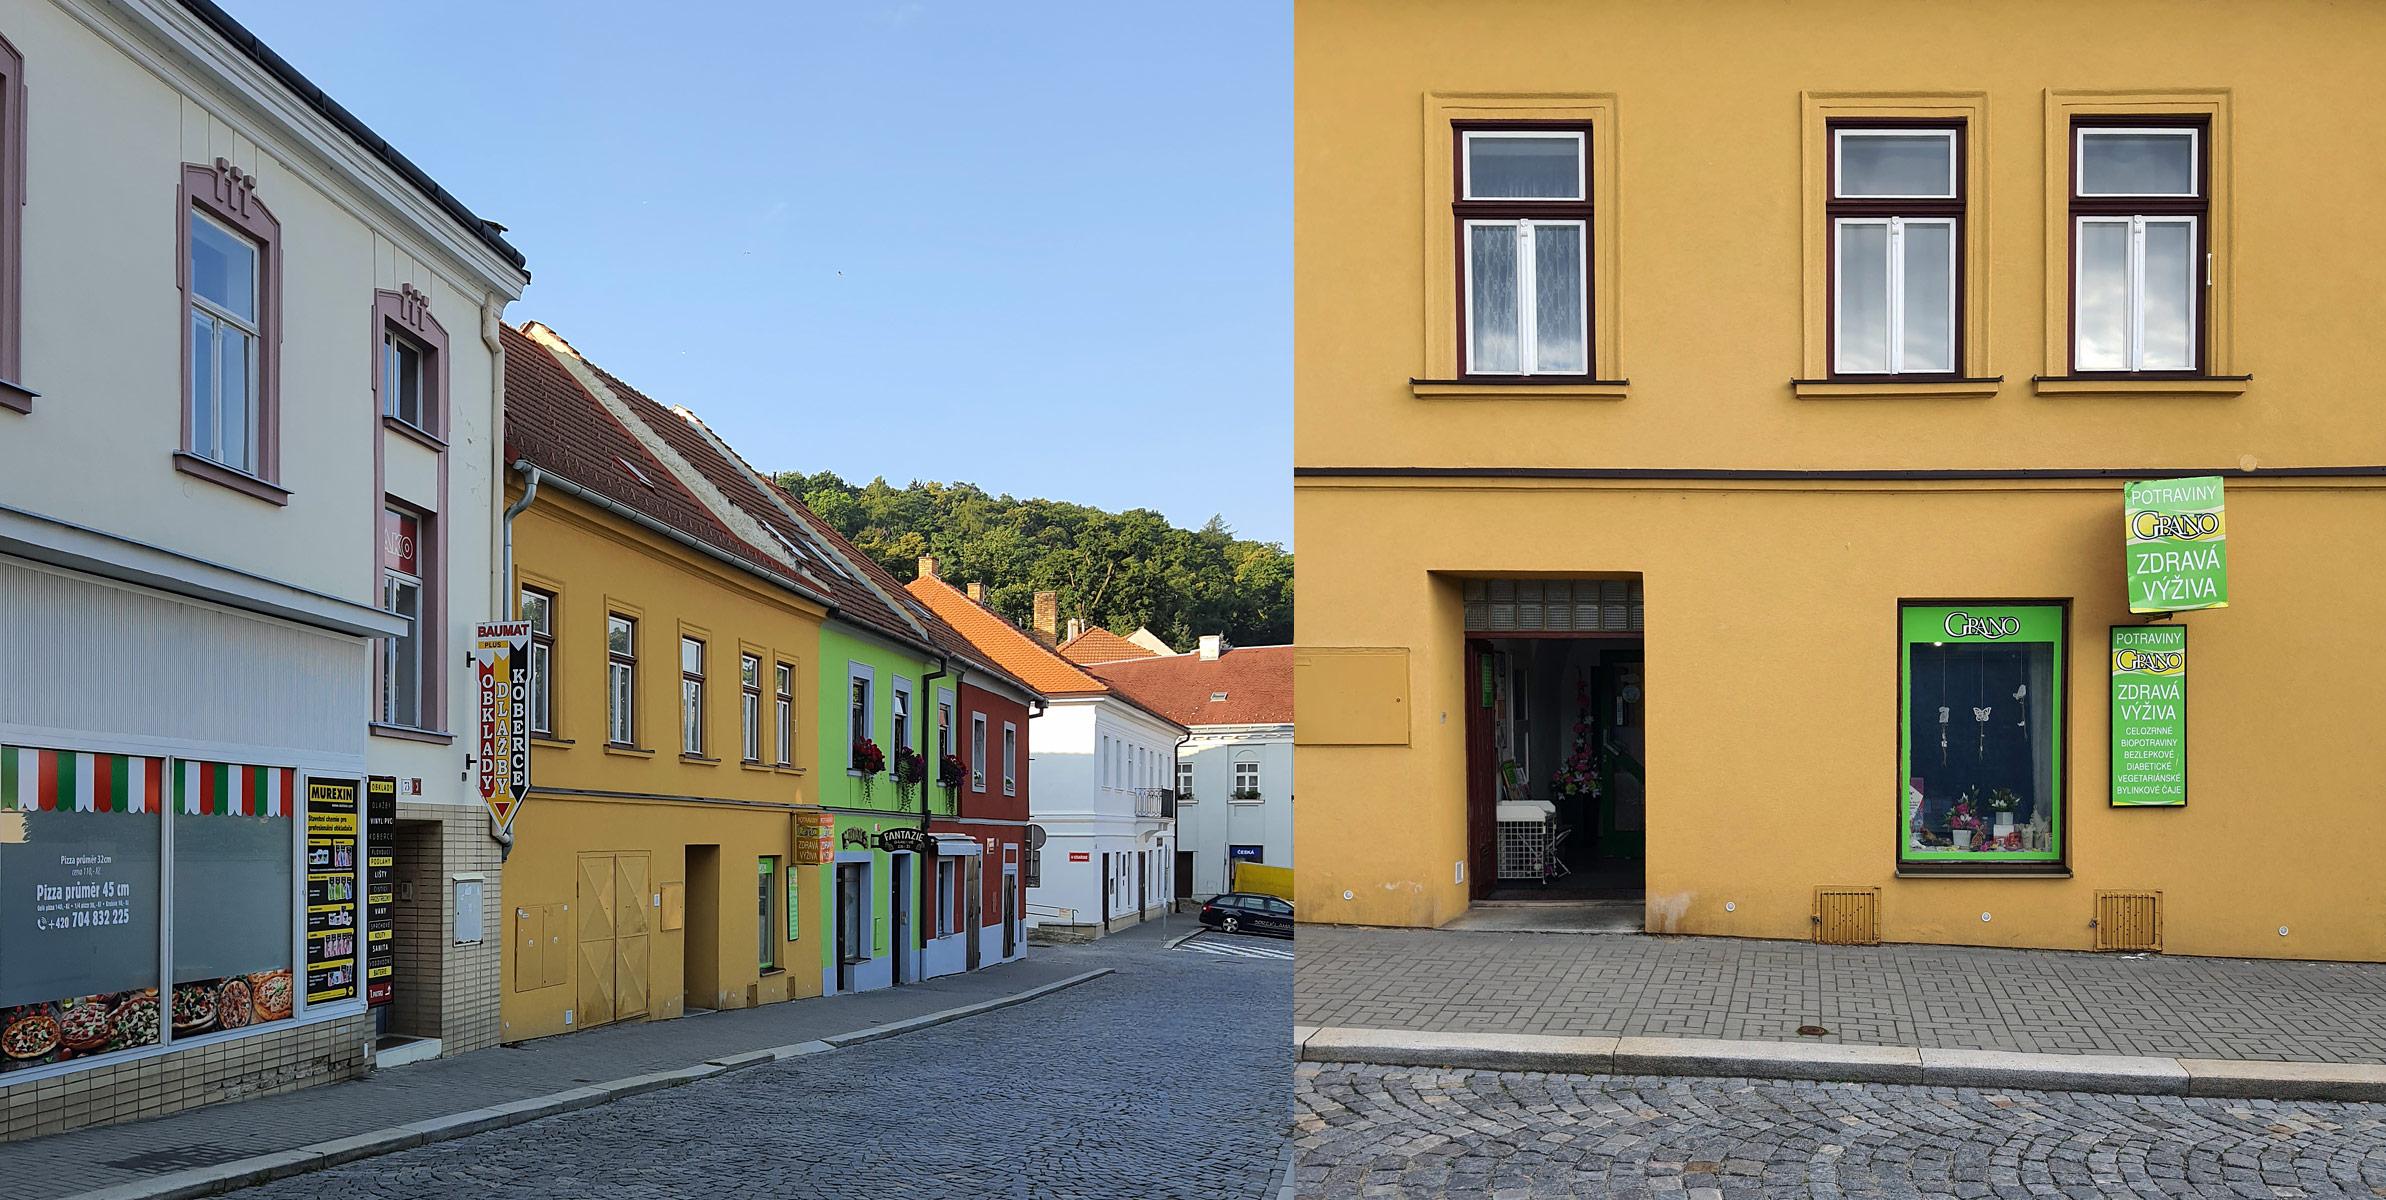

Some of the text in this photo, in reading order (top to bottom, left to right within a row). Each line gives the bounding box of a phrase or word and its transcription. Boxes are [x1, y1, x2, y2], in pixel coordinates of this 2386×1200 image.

[2132, 486, 2217, 506] POTRAVINY
[2136, 544, 2221, 575] ZDRAVÁ
[2142, 574, 2218, 601] VÝŽIVA
[477, 624, 530, 638] BAUMAT
[484, 641, 502, 649] PLUS
[2116, 633, 2182, 645] POTRAVINY
[2118, 680, 2180, 700] ZDRAVÁ
[2121, 701, 2177, 720] VÝŽIVA
[482, 674, 494, 790] OBKLADY
[512, 669, 525, 786] KOBERCE
[2125, 725, 2173, 735] CELOZRNNÉ
[496, 682, 509, 794] DLAŽBY
[2121, 739, 2178, 748] BIOPOTRAVINY
[2124, 749, 2175, 759] BEZLEPKOVÉ
[2126, 761, 2172, 771] DIABETICKÉ
[2117, 773, 2181, 783] VEGETARIÁNSKÉ
[371, 782, 393, 792] OBKLADY
[2117, 784, 2182, 795] BYLINKOVÉ ČAJE
[311, 786, 353, 801] MUREXIN
[883, 830, 925, 842] FANTAZIE
[60, 855, 75, 865] Pizza
[76, 855, 97, 866] průměr
[36, 881, 130, 901] Pizza průměr 45 cm
[374, 907, 387, 915] VANY
[48, 908, 130, 930] +420 704 832 225
[372, 943, 389, 953] SANITA
